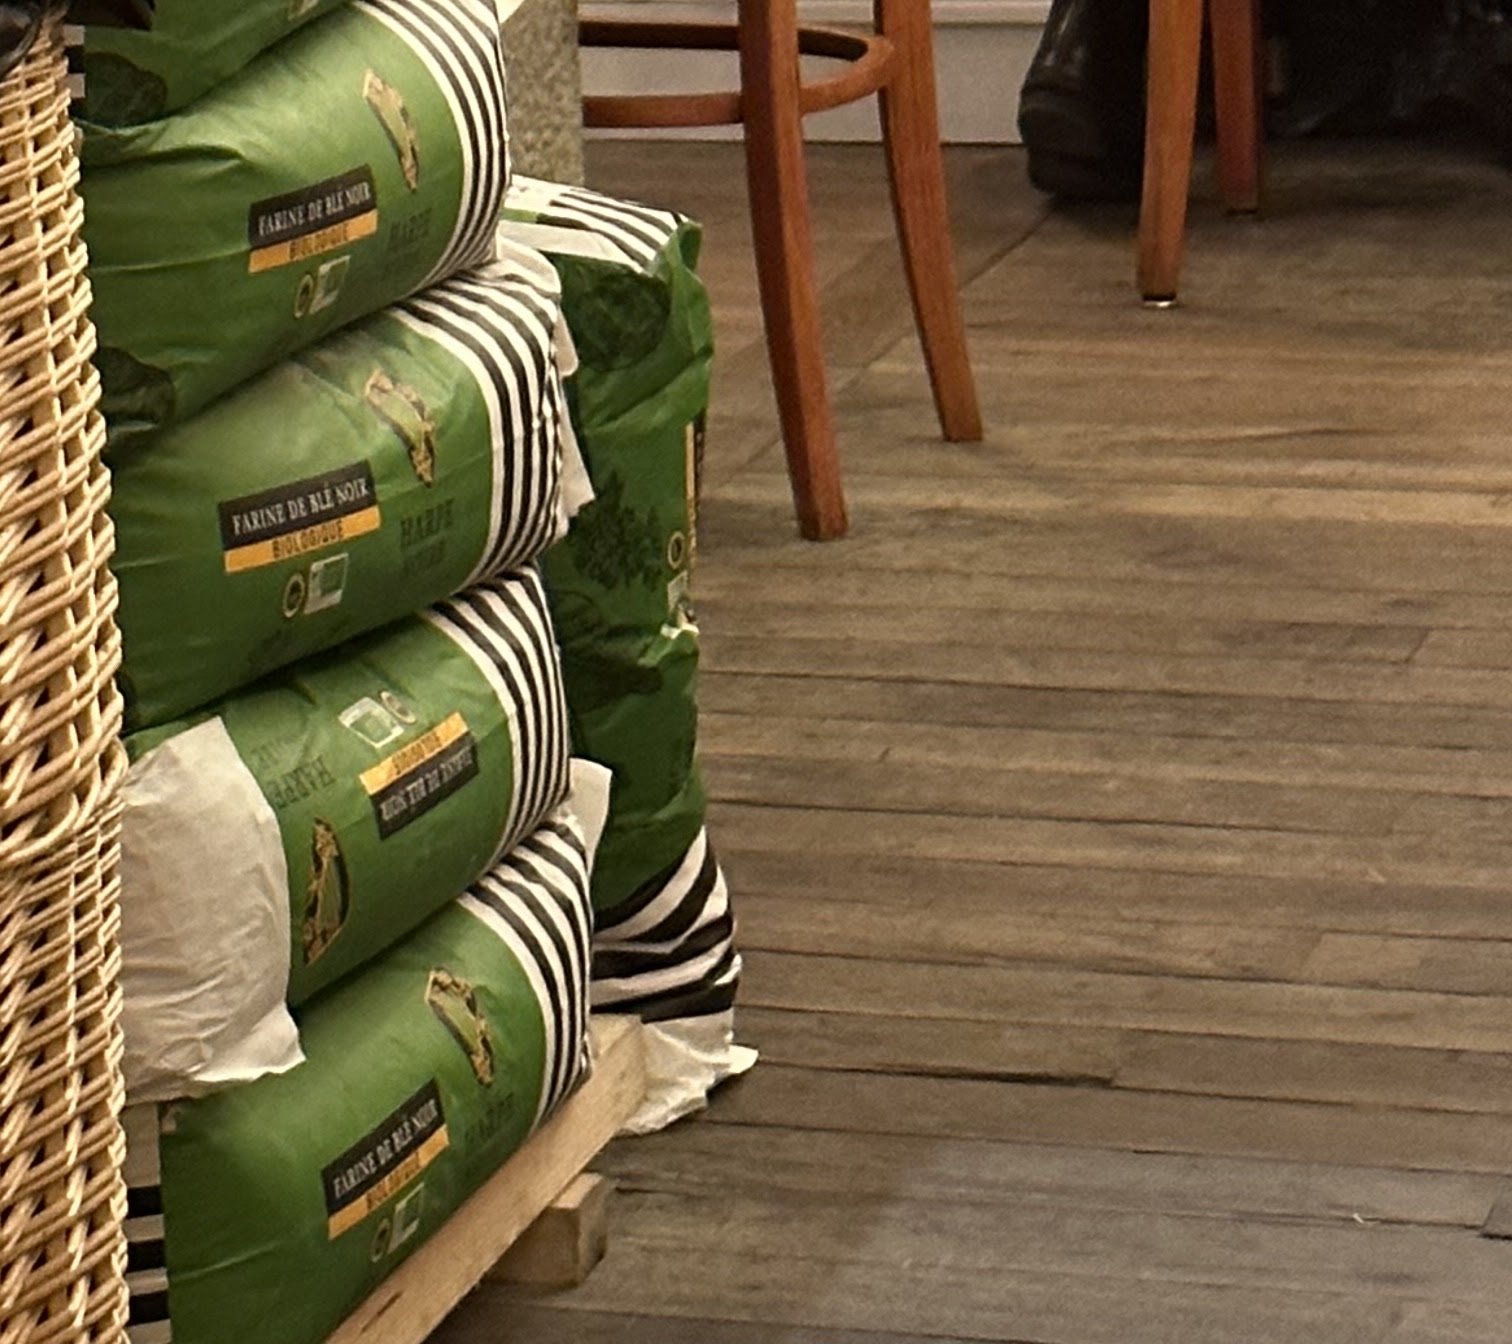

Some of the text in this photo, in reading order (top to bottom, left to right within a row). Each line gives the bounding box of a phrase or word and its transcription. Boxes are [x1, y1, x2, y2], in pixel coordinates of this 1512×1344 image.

[232, 503, 286, 536] FARINE
[287, 499, 307, 520] DE
[336, 478, 370, 504] NOIR
[272, 519, 344, 559] BIOLOGIQUE
